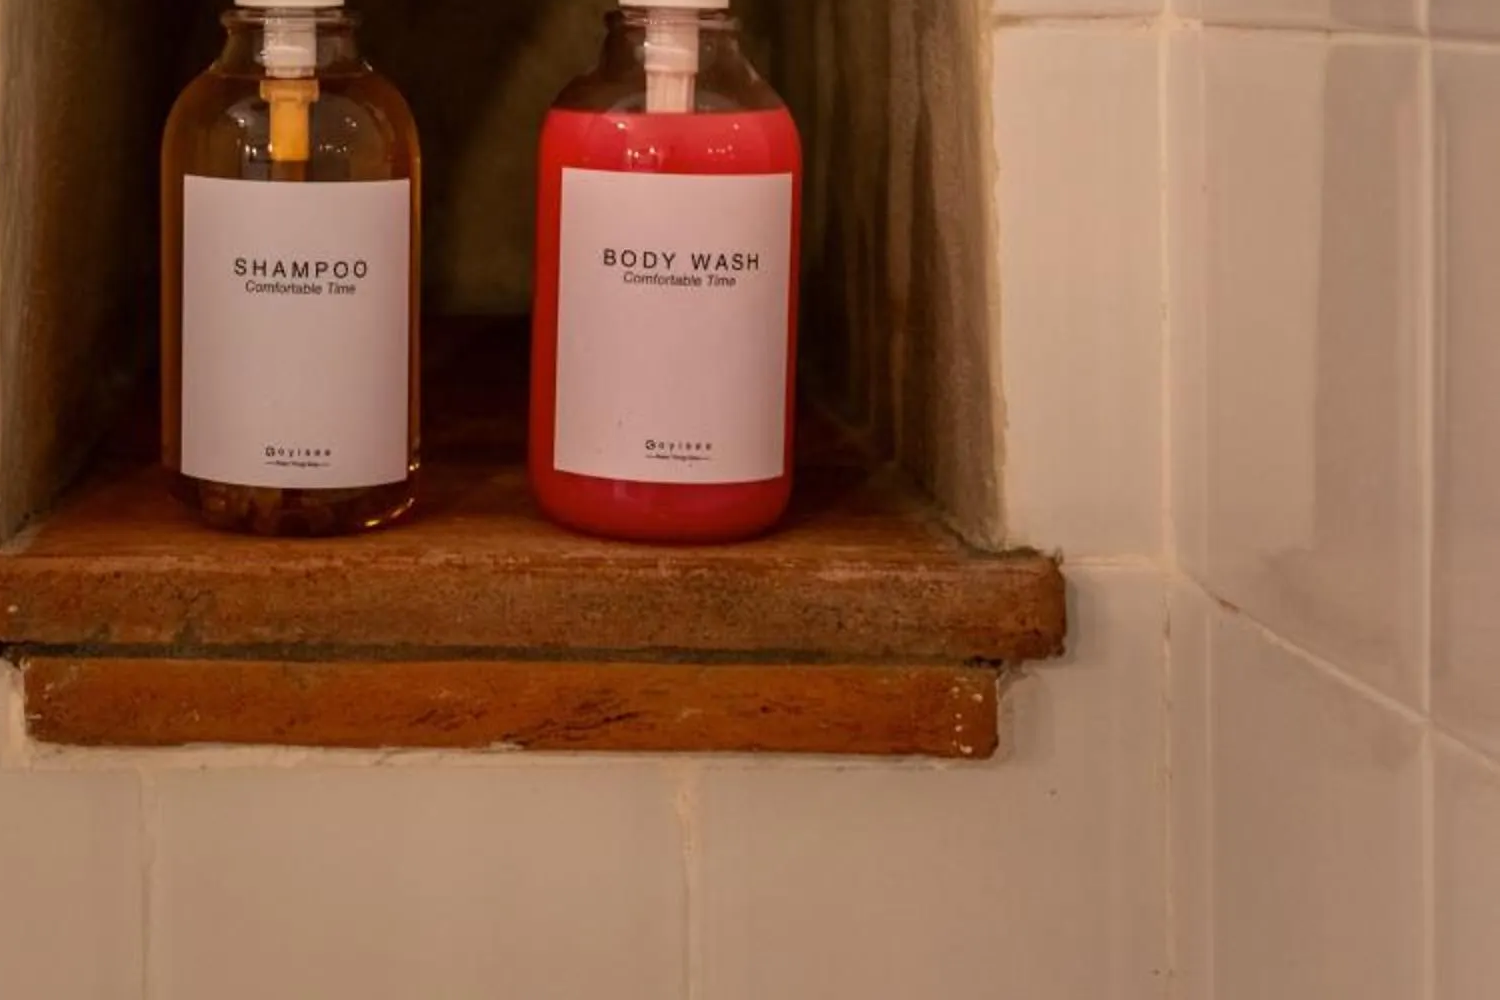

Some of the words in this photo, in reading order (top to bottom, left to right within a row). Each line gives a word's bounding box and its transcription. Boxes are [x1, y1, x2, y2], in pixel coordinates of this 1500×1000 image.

[233, 257, 369, 279] SHAMPOO
[602, 248, 676, 270] BODY
[690, 252, 760, 271] WASH
[244, 279, 323, 295] Comfortable
[327, 281, 357, 295] Time
[622, 271, 703, 287] Comfortable
[706, 273, 737, 288] Time
